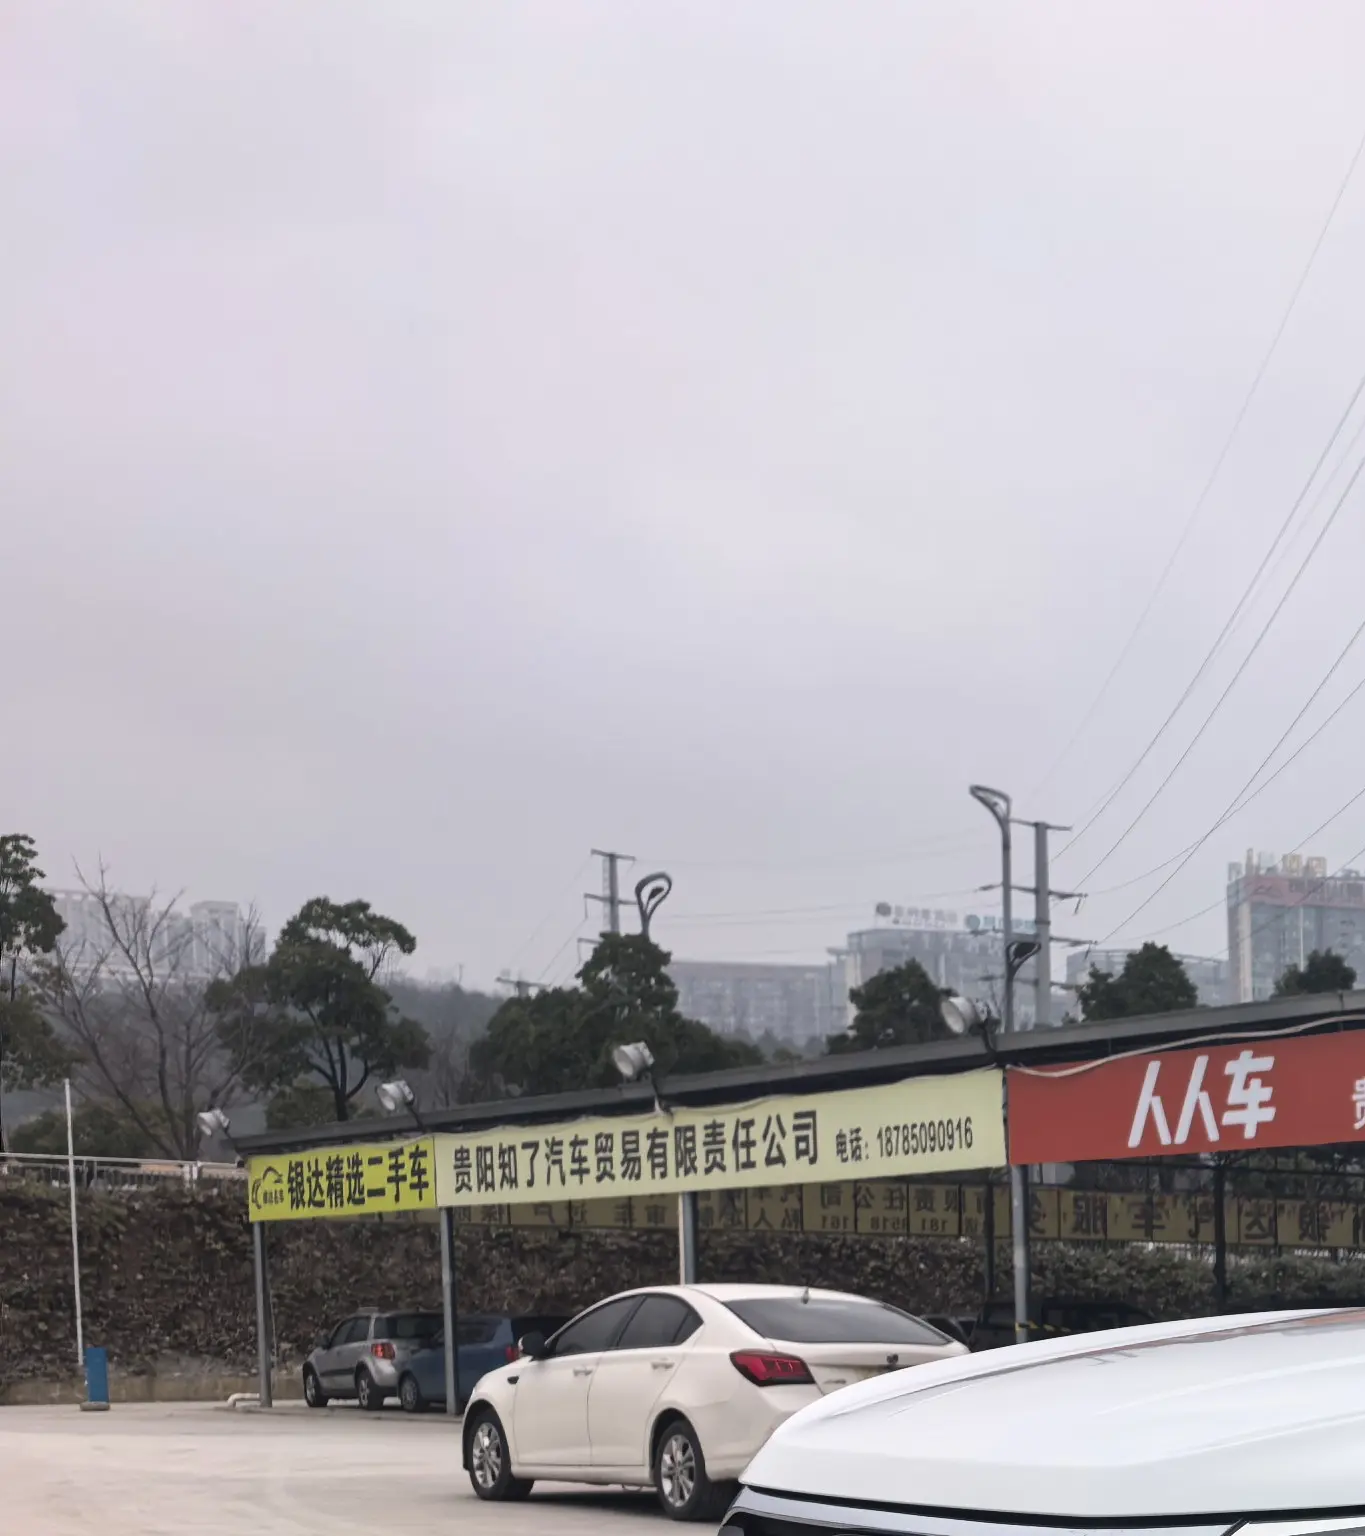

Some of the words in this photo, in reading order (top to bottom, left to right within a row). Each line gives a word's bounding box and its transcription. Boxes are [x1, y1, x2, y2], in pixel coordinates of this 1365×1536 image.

[1127, 1050, 1276, 1148] 人人车
[287, 1144, 430, 1211] 银达精选二手车
[453, 1110, 819, 1194] 贵阳知了汽车贸易有限责任公司
[876, 1116, 974, 1158] 18785090916
